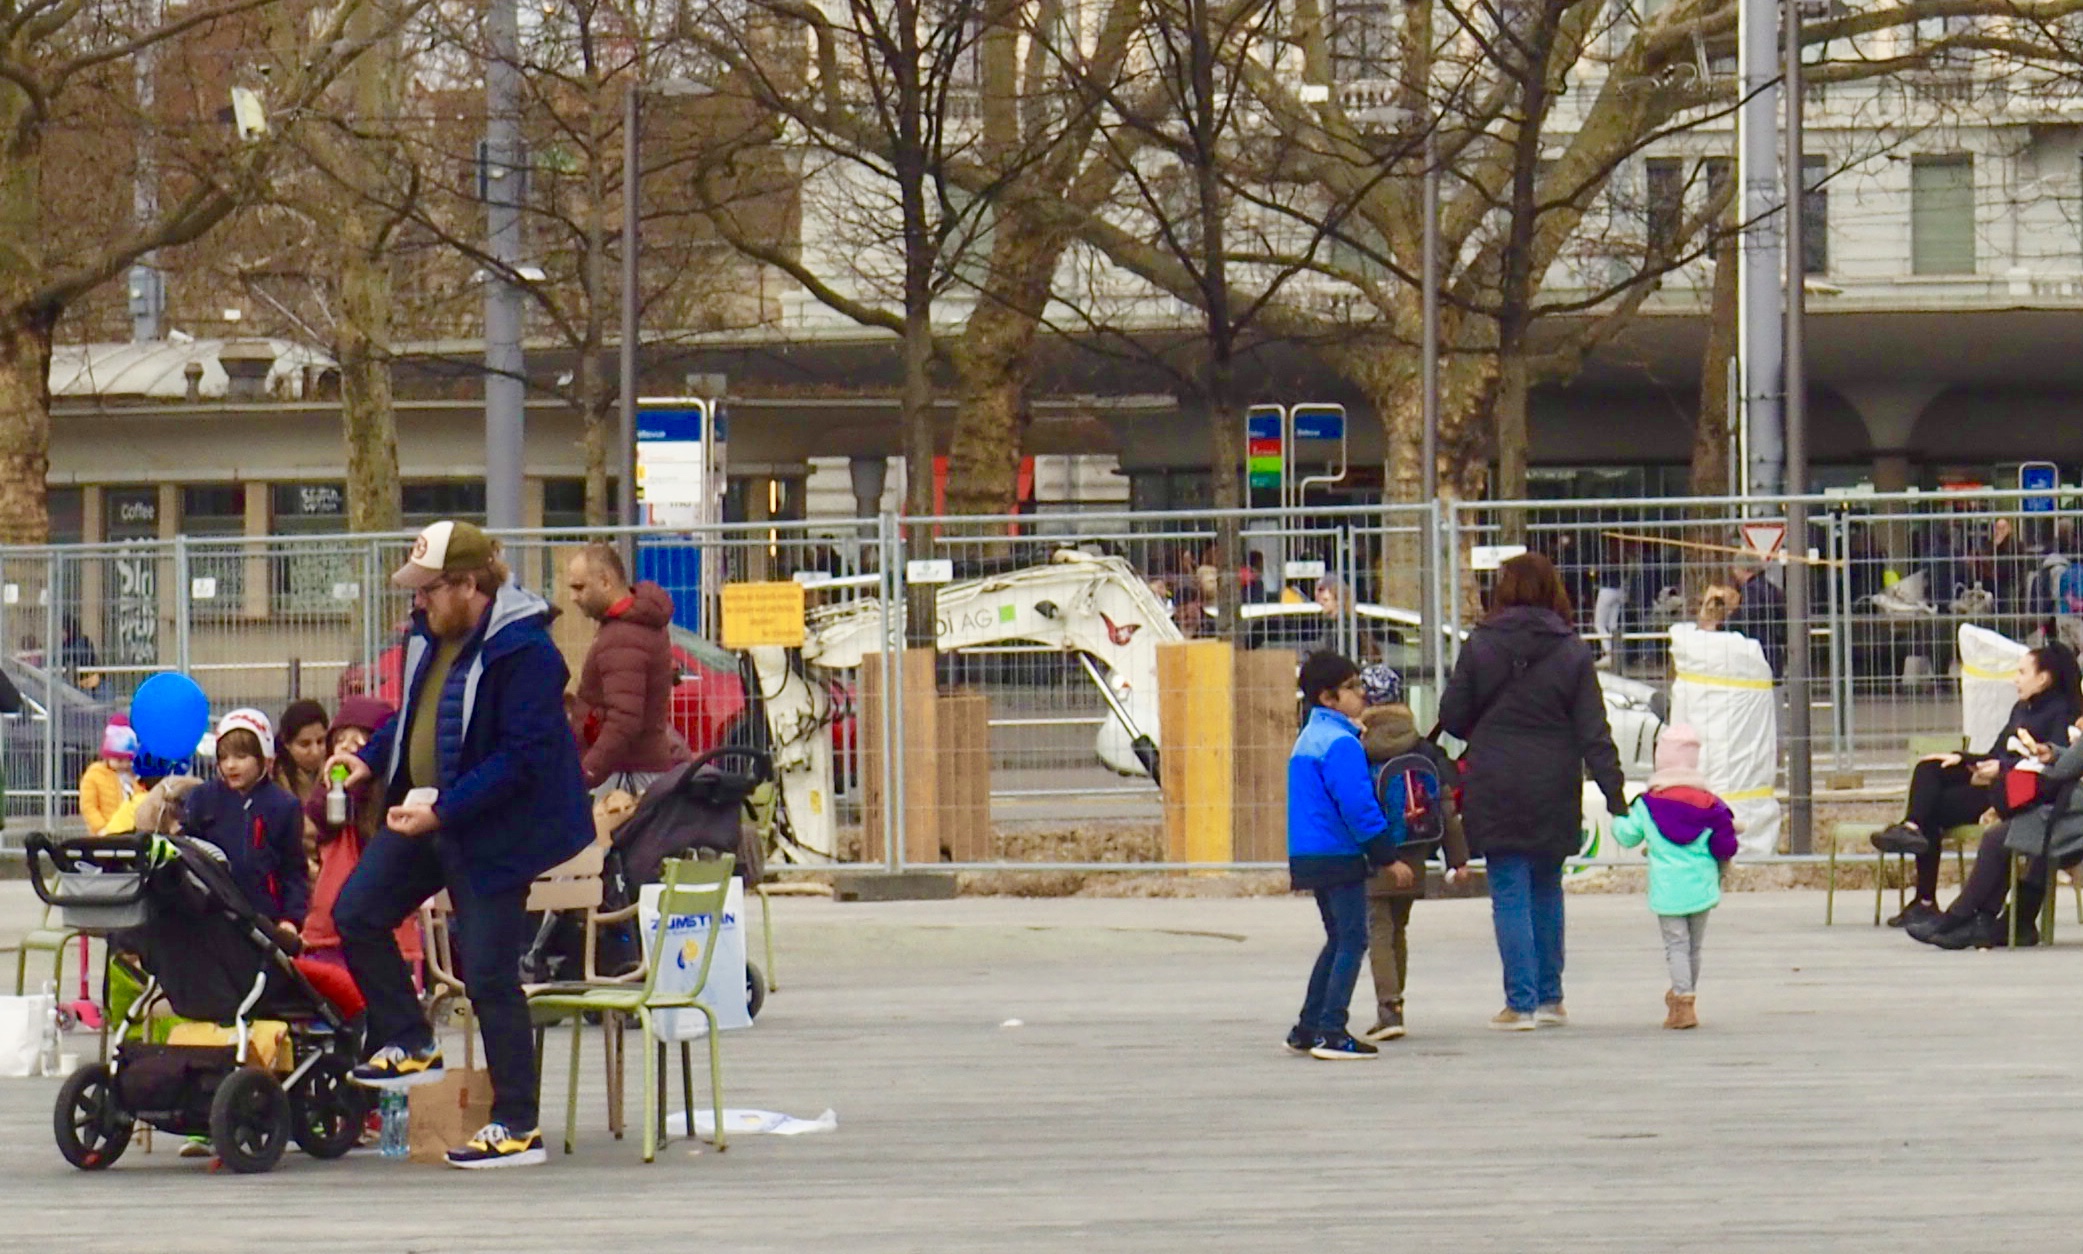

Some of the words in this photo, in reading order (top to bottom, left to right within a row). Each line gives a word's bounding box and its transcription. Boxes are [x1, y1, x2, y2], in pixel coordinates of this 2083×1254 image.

[121, 502, 155, 520] Coffee
[961, 608, 993, 632] AG
[651, 912, 735, 930] ZUMSTIN
